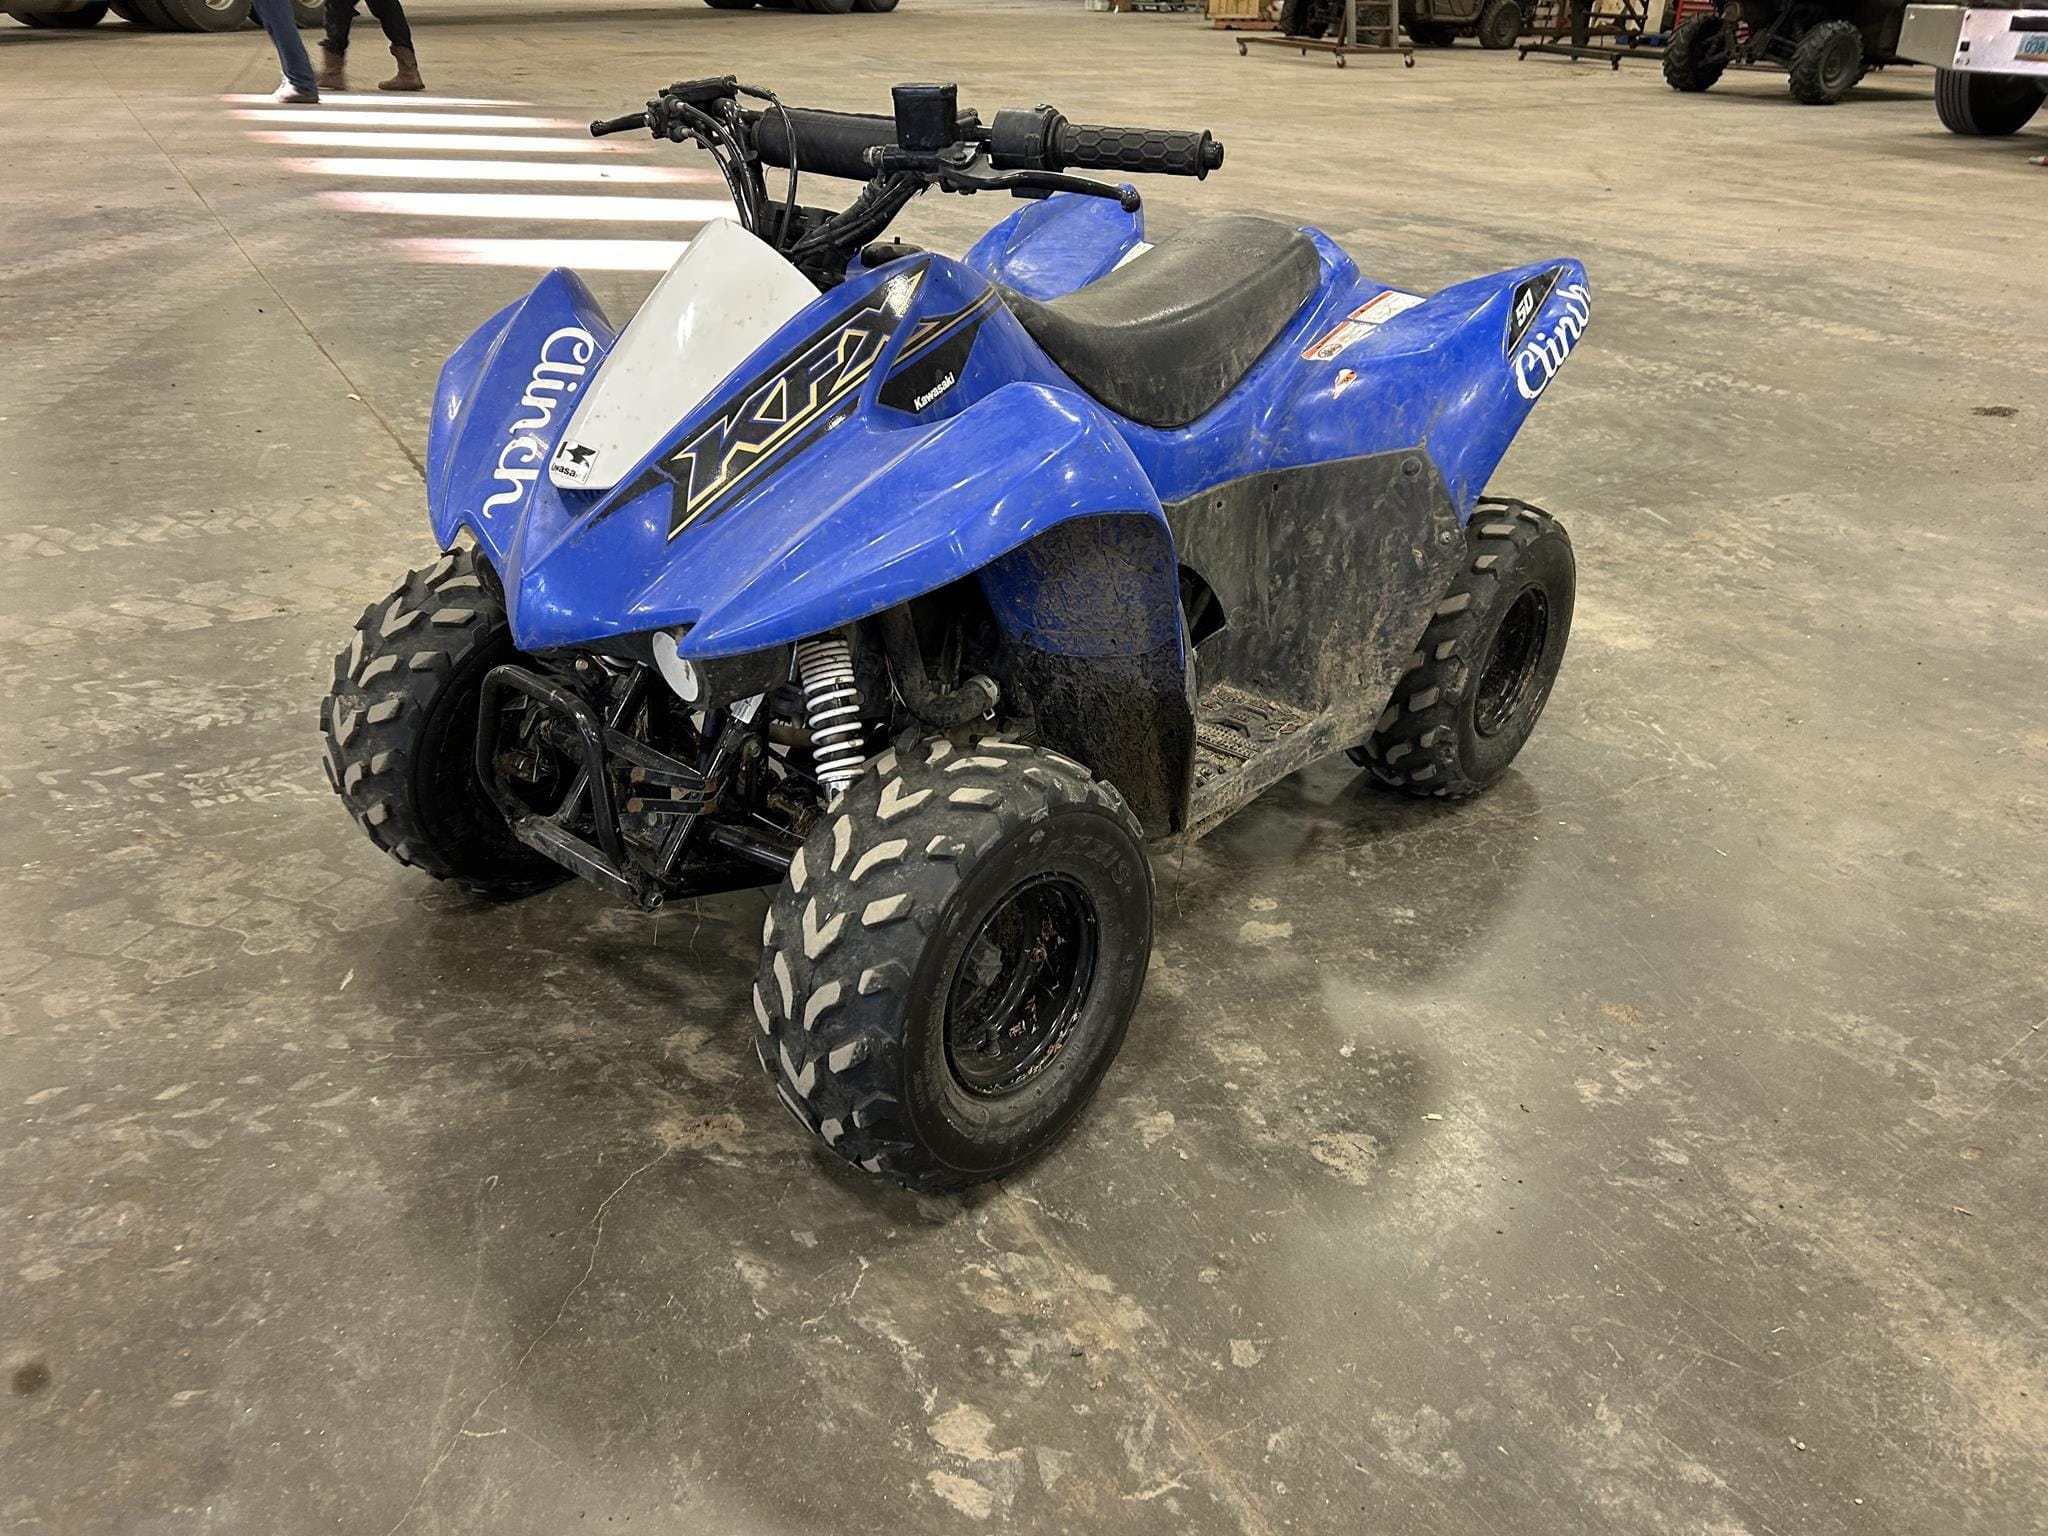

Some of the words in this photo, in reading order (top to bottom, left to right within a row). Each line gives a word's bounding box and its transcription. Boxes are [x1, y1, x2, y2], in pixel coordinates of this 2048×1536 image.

[1515, 288, 1534, 328] 50
[482, 326, 595, 519] Clinch
[671, 270, 951, 513] KFX
[913, 371, 956, 411] Kawasaki
